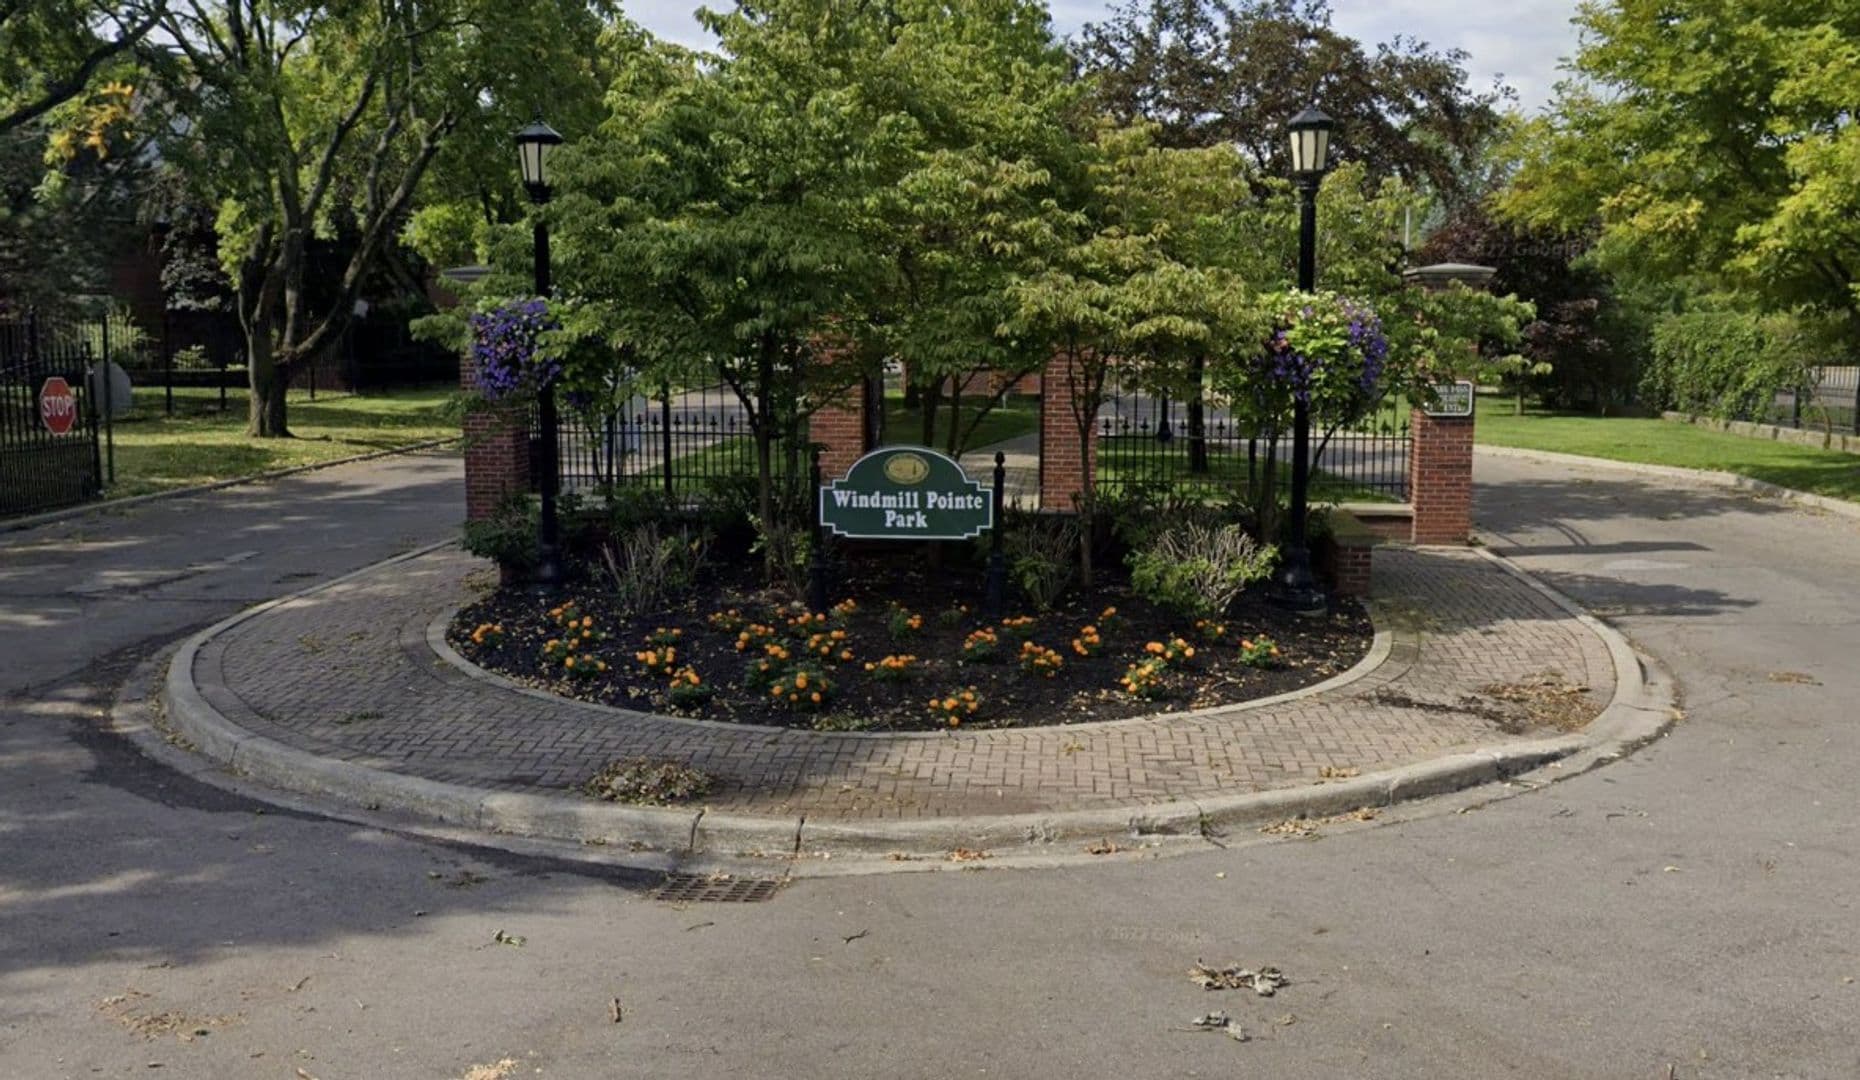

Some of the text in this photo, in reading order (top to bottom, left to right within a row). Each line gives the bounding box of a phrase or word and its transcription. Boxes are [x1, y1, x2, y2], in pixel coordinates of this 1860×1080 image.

[43, 395, 74, 417] STOP
[832, 490, 983, 509] Windmill Pointe
[884, 510, 928, 528] Park
